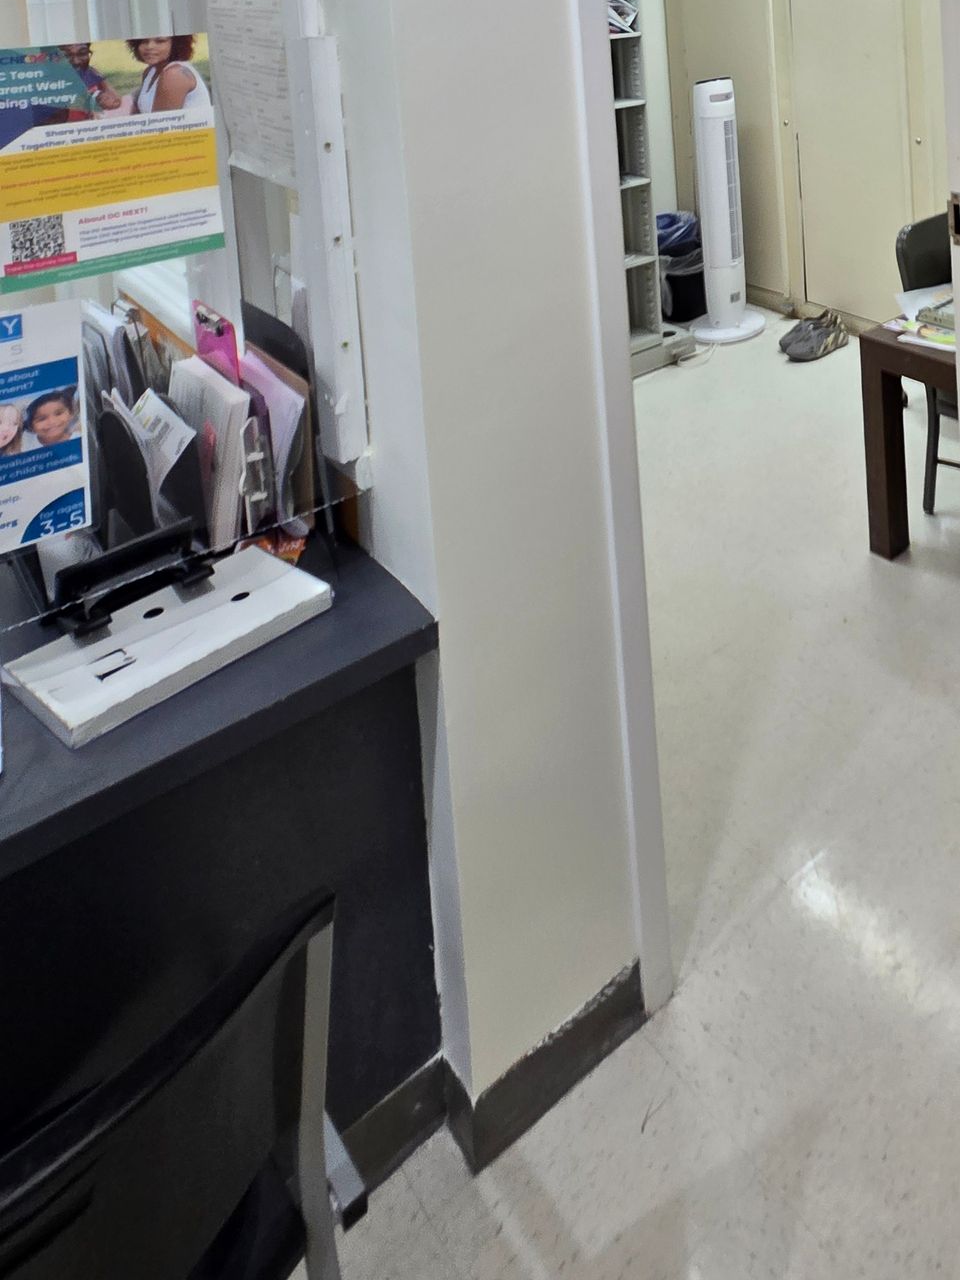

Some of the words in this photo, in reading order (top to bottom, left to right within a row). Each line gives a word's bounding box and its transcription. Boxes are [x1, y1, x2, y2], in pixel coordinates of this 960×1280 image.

[10, 70, 44, 80] Teen
[36, 79, 73, 91] Well-
[31, 93, 77, 106] Survey
[45, 128, 75, 138] Share
[77, 126, 99, 136] your
[100, 120, 147, 132] parenting
[106, 130, 134, 140] make
[135, 125, 170, 135] change
[78, 213, 106, 225] About
[107, 211, 121, 220] DC
[7, 369, 39, 384] about
[9, 462, 44, 479] child's
[40, 511, 55, 521] for
[57, 501, 84, 516] ages
[40, 510, 84, 537] 3-5
